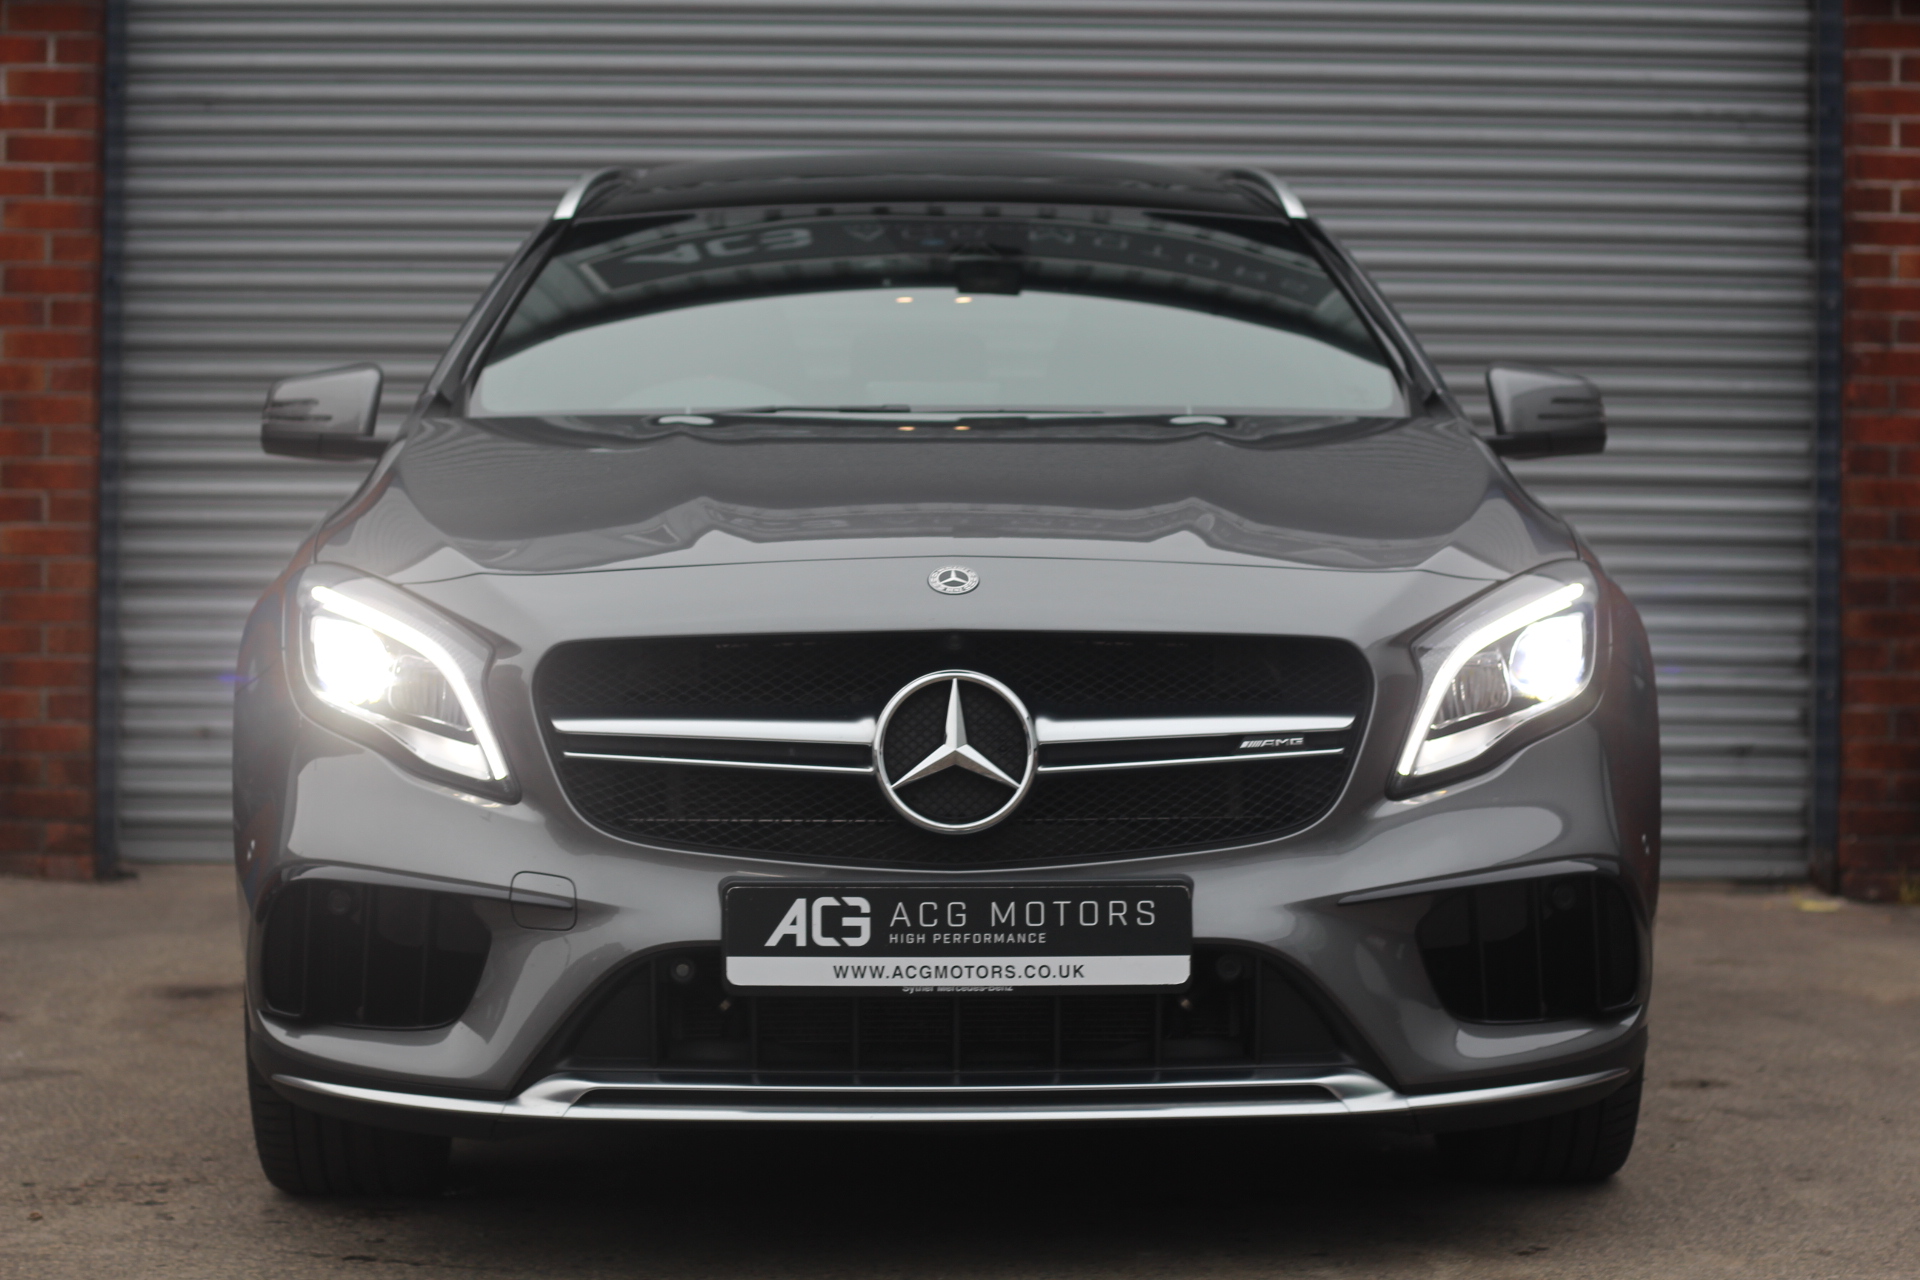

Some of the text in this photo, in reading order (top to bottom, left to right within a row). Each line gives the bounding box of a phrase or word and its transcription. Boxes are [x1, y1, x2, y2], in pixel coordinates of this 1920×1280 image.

[1260, 737, 1304, 748] AMG
[764, 896, 871, 947] ACG
[889, 900, 1156, 928] ACG MOTORS
[889, 932, 1047, 944] HIGH PERFORMANCE
[833, 964, 1085, 980] WWW.ACGMOTORS.CO.UK
